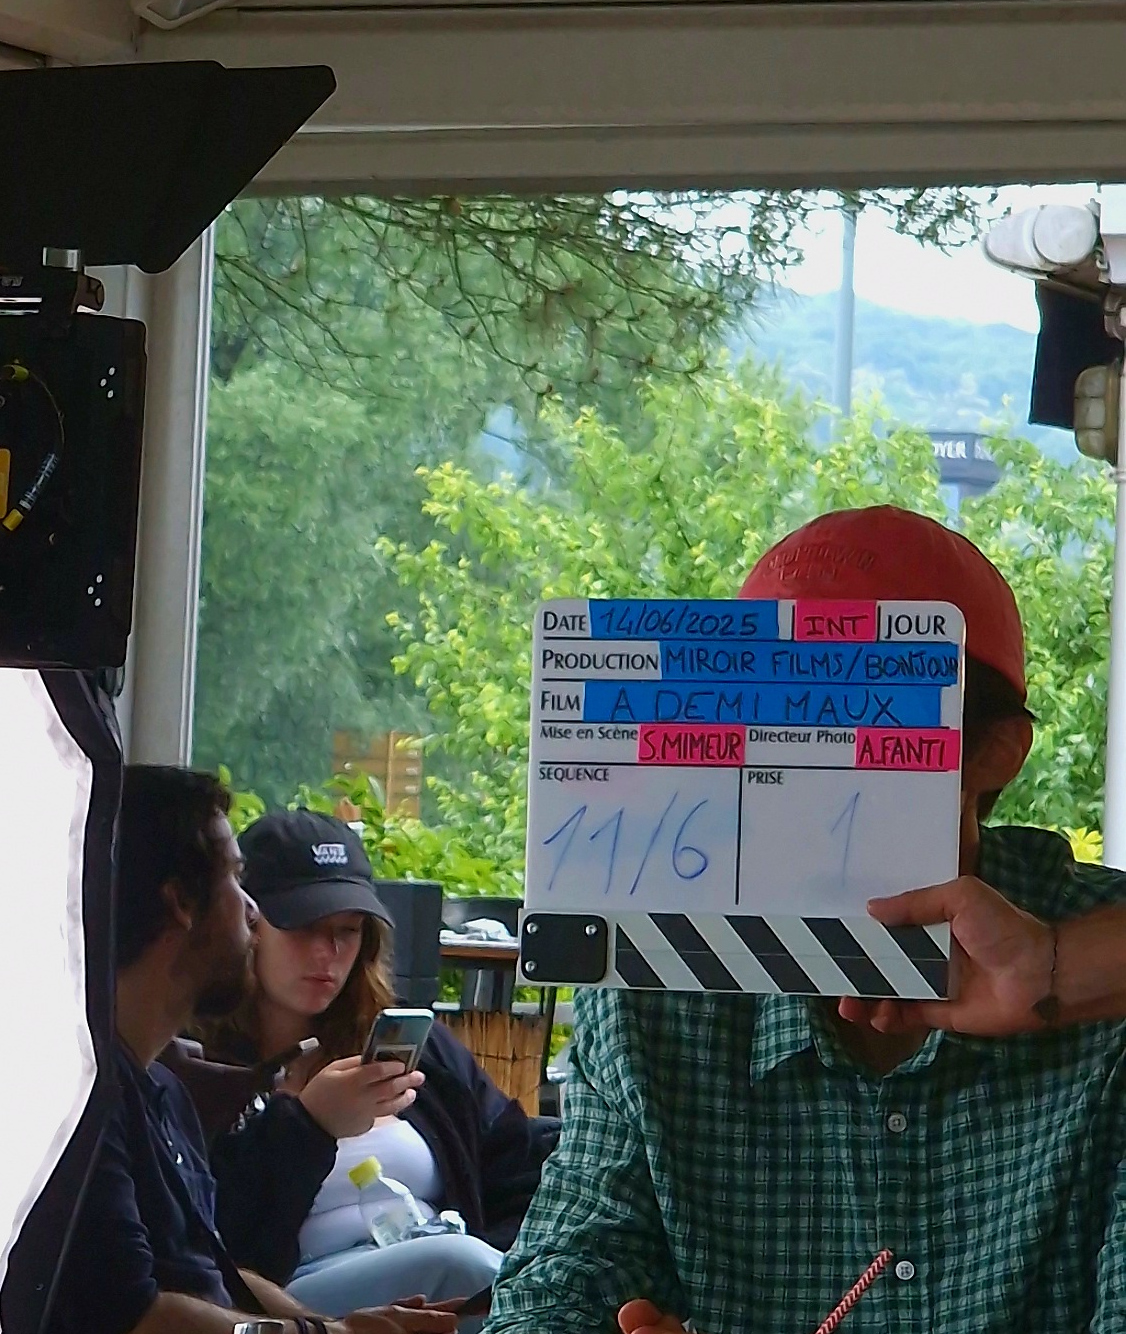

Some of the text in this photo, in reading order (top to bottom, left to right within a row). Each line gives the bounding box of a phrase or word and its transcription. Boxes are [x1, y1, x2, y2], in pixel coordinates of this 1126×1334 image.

[599, 603, 758, 637] 14/06/2025
[803, 615, 869, 637] INT
[885, 614, 947, 639] JOUR
[665, 645, 756, 675] MIROIR
[610, 686, 903, 727] A DEMI MAUX
[540, 727, 638, 741] Mise en Scène
[638, 730, 741, 762] S.MIMEUR
[749, 729, 856, 744] Directeur Photo
[747, 771, 784, 785] PRISE
[543, 791, 709, 896] 11/6
[830, 792, 861, 888] 1
